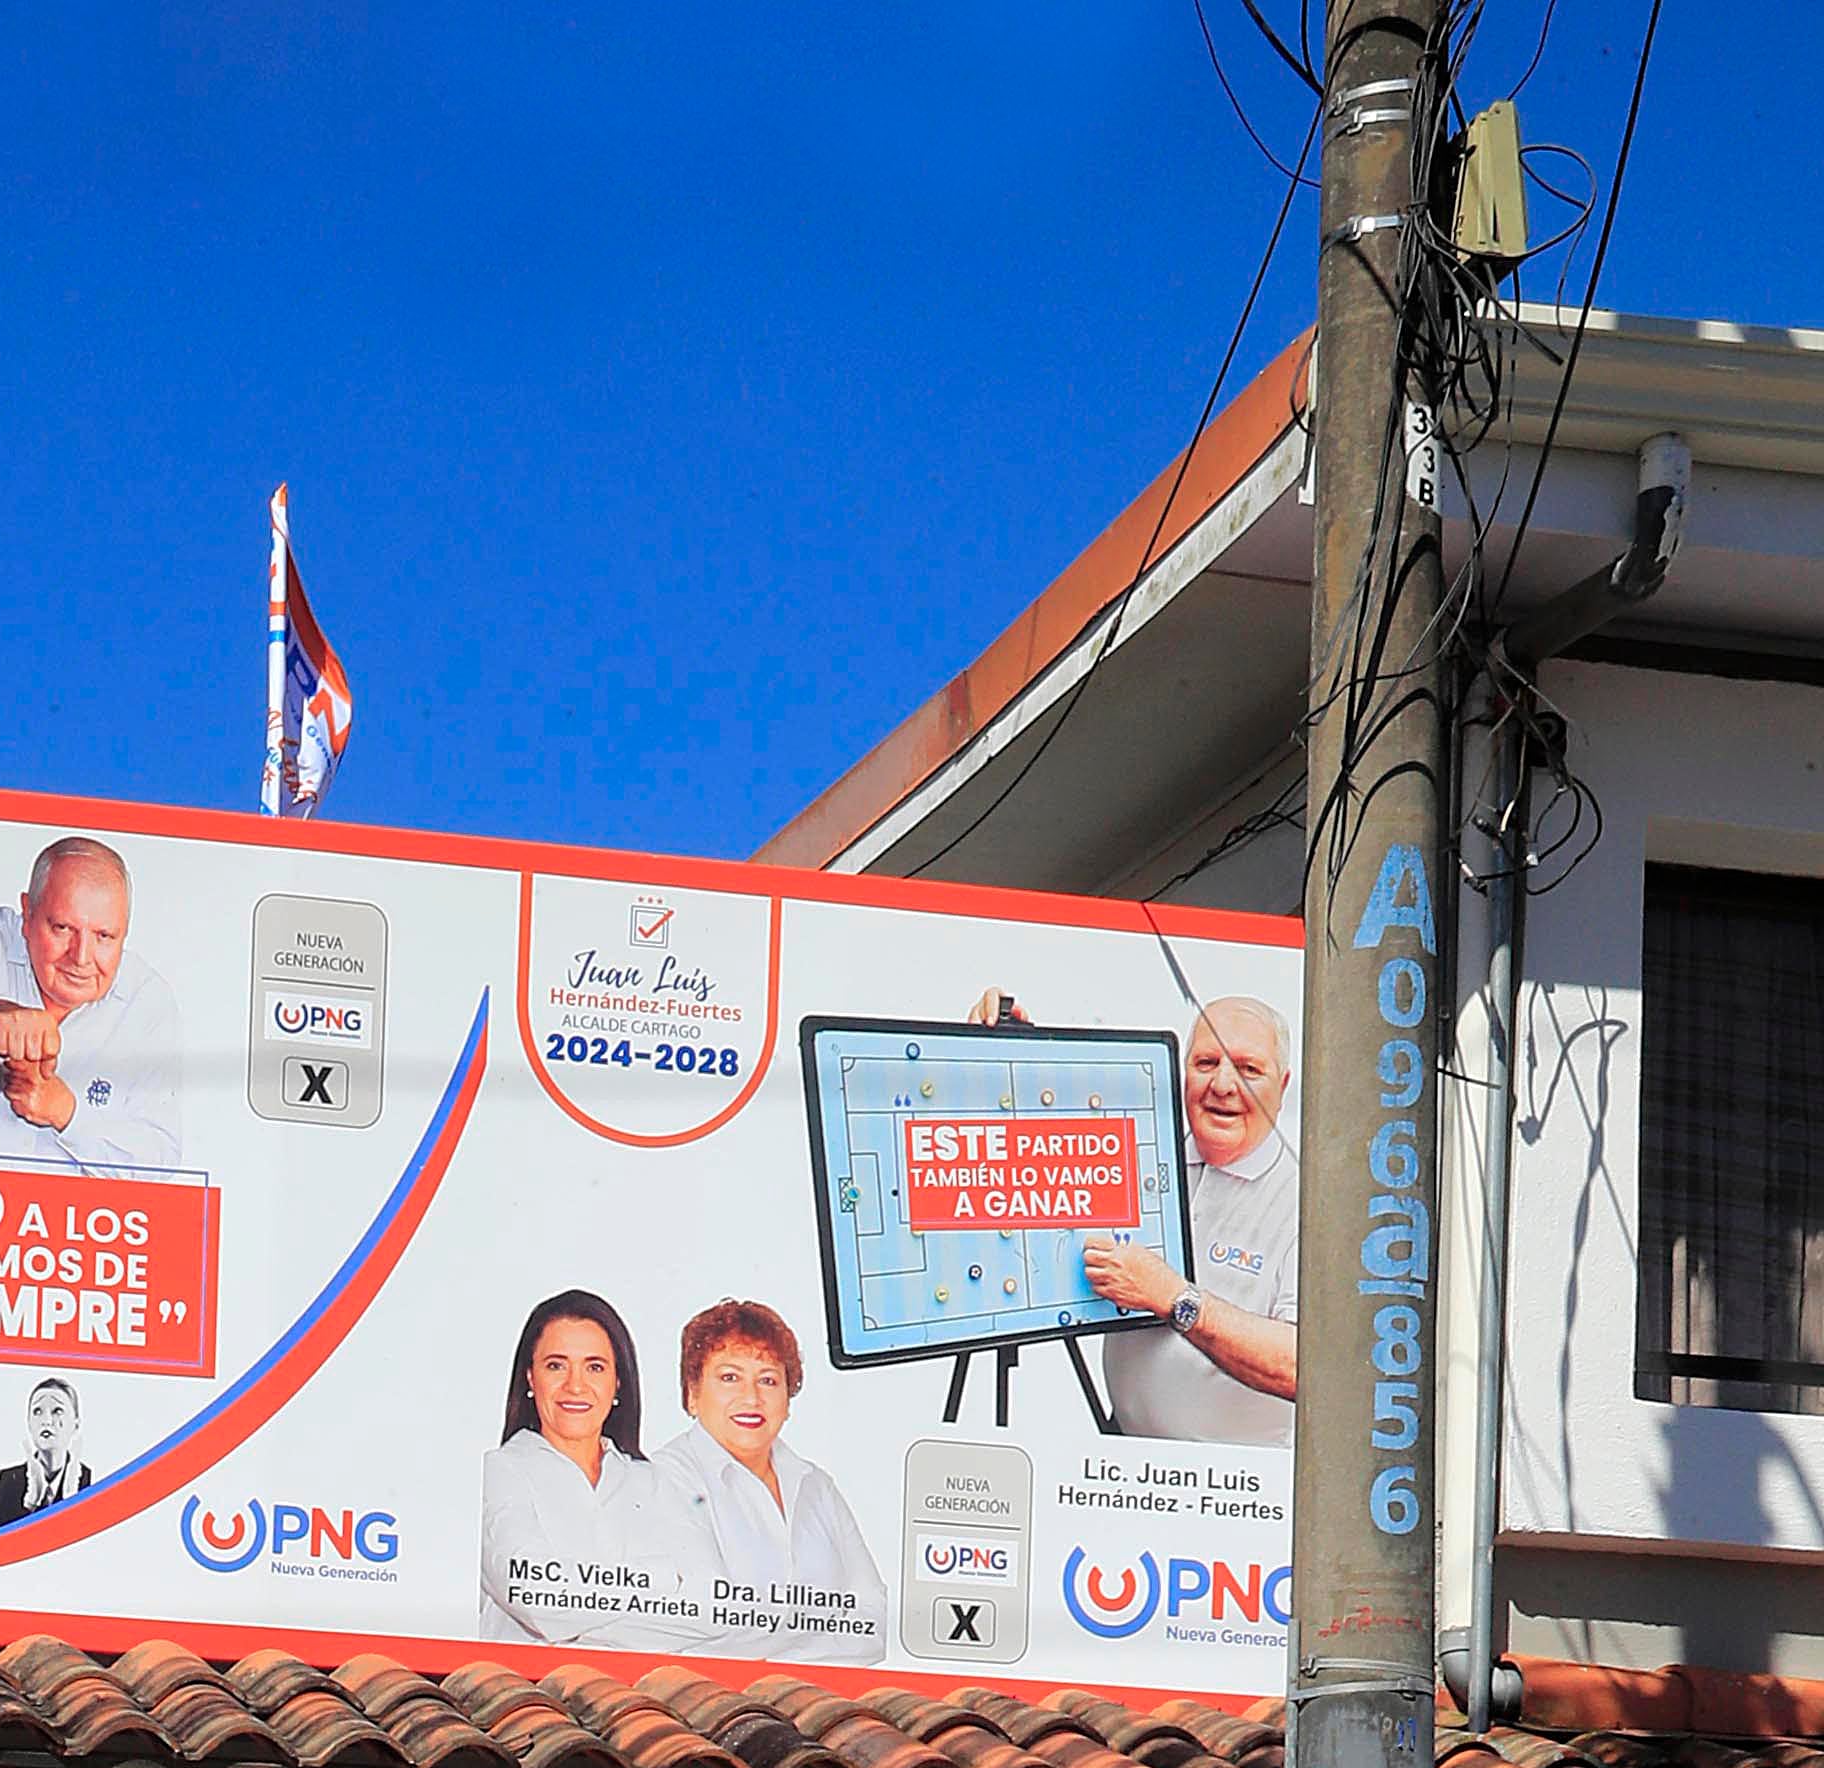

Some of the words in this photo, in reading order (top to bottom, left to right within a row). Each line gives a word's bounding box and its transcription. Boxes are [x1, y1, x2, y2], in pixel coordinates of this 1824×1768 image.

[296, 932, 344, 951] NUEVA
[274, 951, 364, 974] GENERACIÓN
[566, 949, 644, 990] Juan
[652, 955, 717, 1002] Luis
[549, 987, 742, 1023] Hernández-Fuertes
[561, 1013, 627, 1033] ALCALDE
[630, 1019, 702, 1040] CARTAGO
[545, 1032, 740, 1078] 2024-2028
[298, 1063, 334, 1105] X
[910, 1124, 1009, 1162] ESTE
[1016, 1133, 1121, 1158] PARTIDO
[910, 1162, 1006, 1189] TAMBIÉN
[1010, 1167, 1037, 1187] LO
[1042, 1165, 1123, 1187] VAMOS
[952, 1192, 976, 1219] A
[983, 1189, 1093, 1218] GANAR
[17, 1202, 50, 1239] A
[66, 1205, 150, 1246] LOS
[94, 1250, 149, 1290] DE
[945, 1476, 990, 1494] NUEVA
[1082, 1458, 1129, 1484] Lic.
[1136, 1462, 1198, 1489] Juan
[1206, 1465, 1261, 1493] Luis
[924, 1495, 1011, 1515] GENERACIÓN
[1057, 1484, 1178, 1513] Hernández
[1200, 1496, 1285, 1522] Fuertes
[271, 1560, 315, 1577] Nueva
[318, 1564, 398, 1583] Generación
[508, 1558, 569, 1584] MsC.
[577, 1563, 651, 1589] Vielka
[507, 1585, 621, 1613] Fernández
[626, 1594, 700, 1618] Arrieta
[712, 1579, 762, 1603] Dra.
[769, 1583, 857, 1610] Lilliana
[711, 1606, 780, 1634] Harley
[786, 1610, 876, 1636] Jiménez
[947, 1603, 981, 1643] X
[1166, 1625, 1217, 1645] Nueva
[1221, 1628, 1288, 1650] Generac
